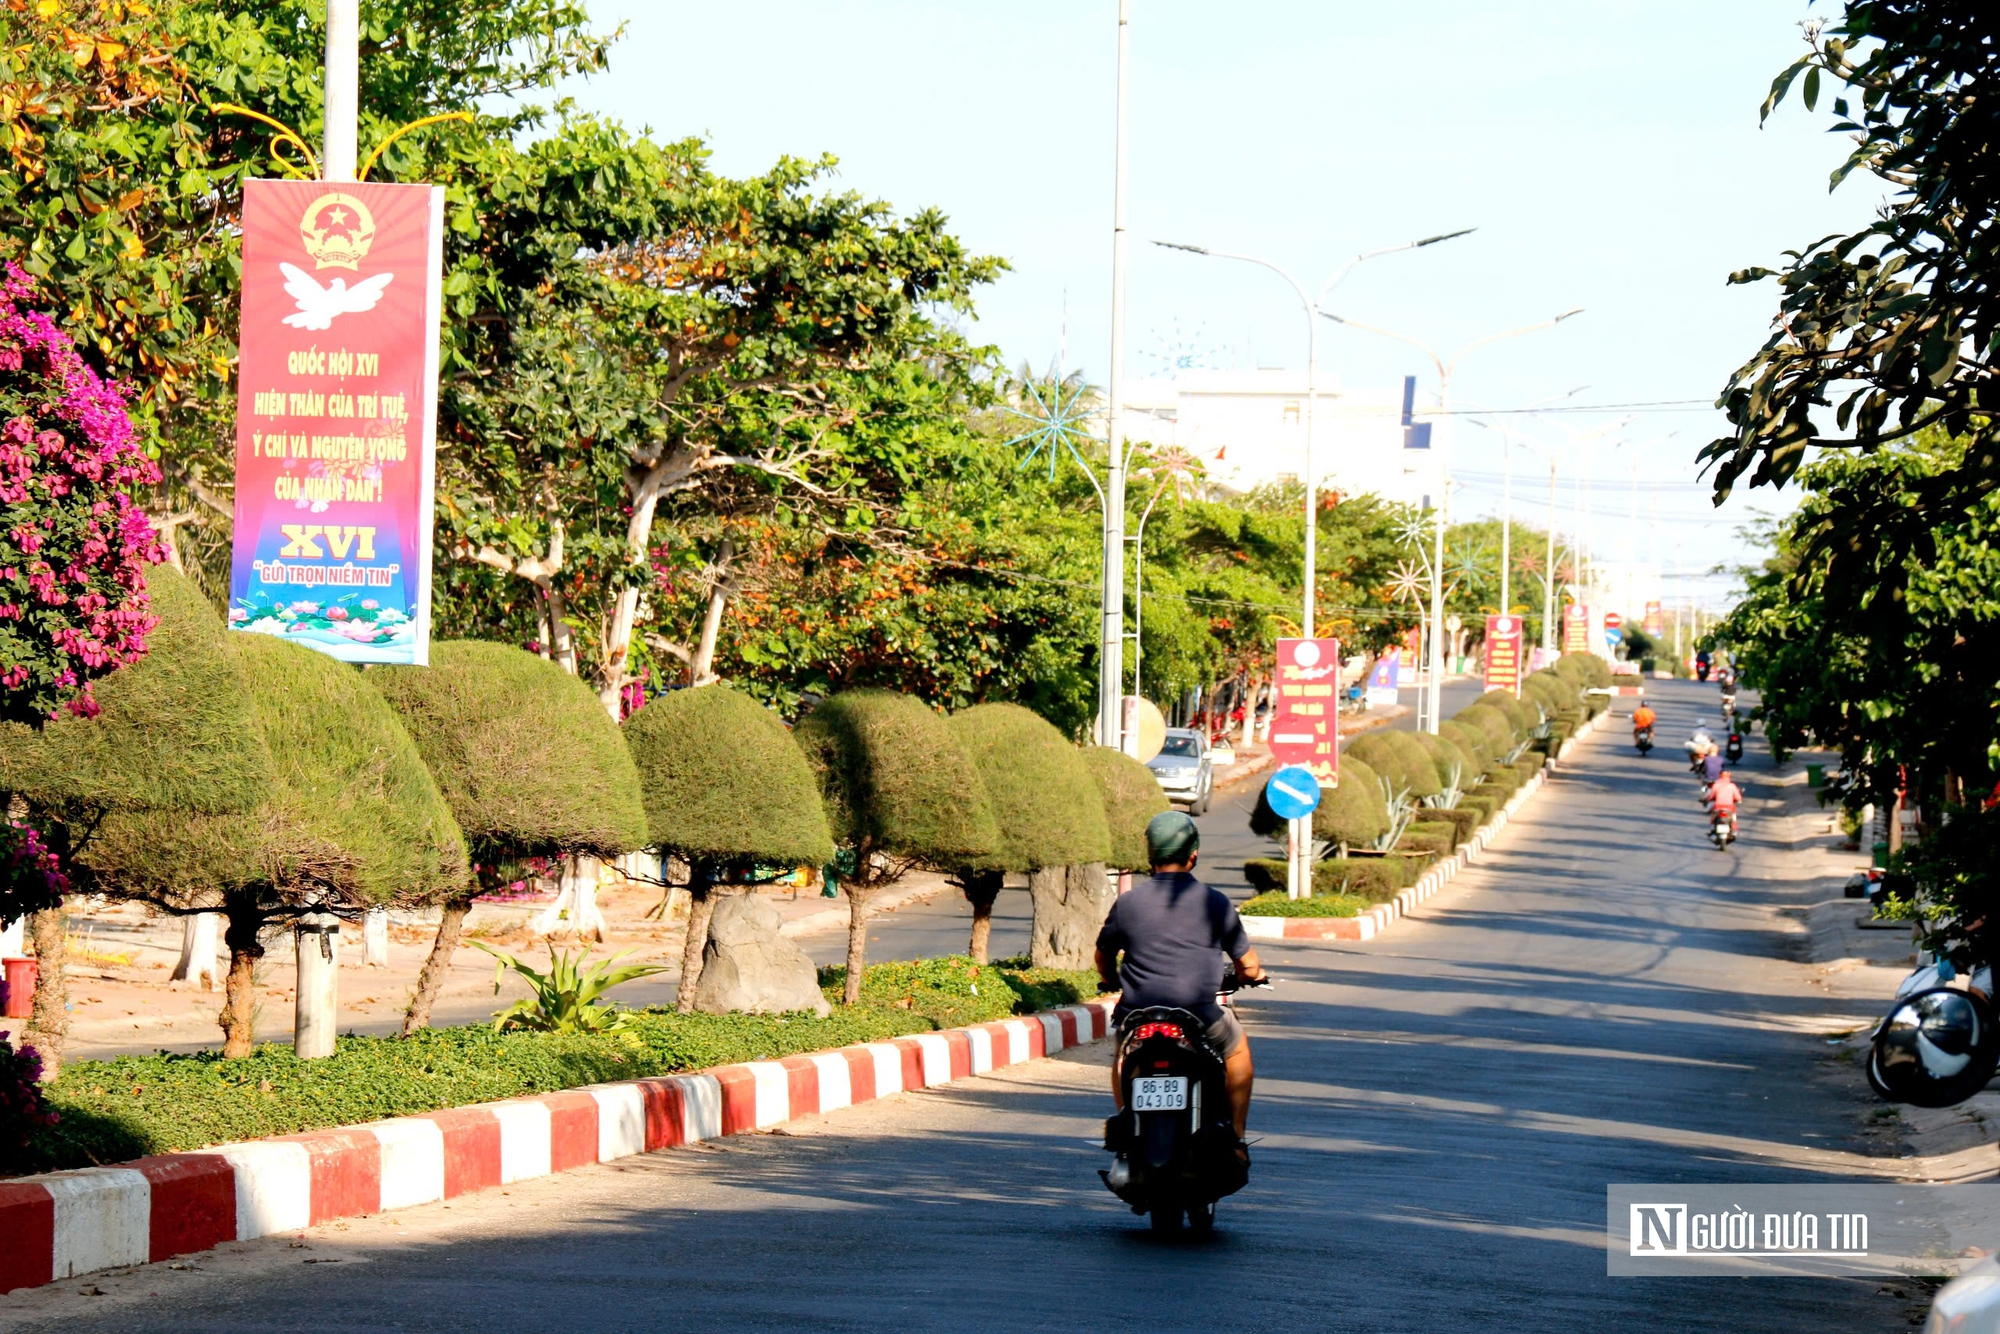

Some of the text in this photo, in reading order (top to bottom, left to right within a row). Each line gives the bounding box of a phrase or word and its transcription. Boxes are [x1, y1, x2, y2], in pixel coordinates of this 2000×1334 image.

[287, 344, 379, 381] QUỐC HỘI XVI
[254, 388, 409, 424] HIỆN THÂN CỦA TRÍ TUỆ,
[252, 429, 407, 466] Ý CHÍ VÀ NGUYỆN VỌNG
[274, 470, 301, 500] CỦA
[303, 474, 343, 501] NHÂN
[345, 474, 374, 502] DÂN
[279, 525, 376, 560] XVI
[288, 564, 326, 587] TRỌN
[1136, 1094, 1182, 1108] 043.09
[1142, 1080, 1178, 1093] 86-B9
